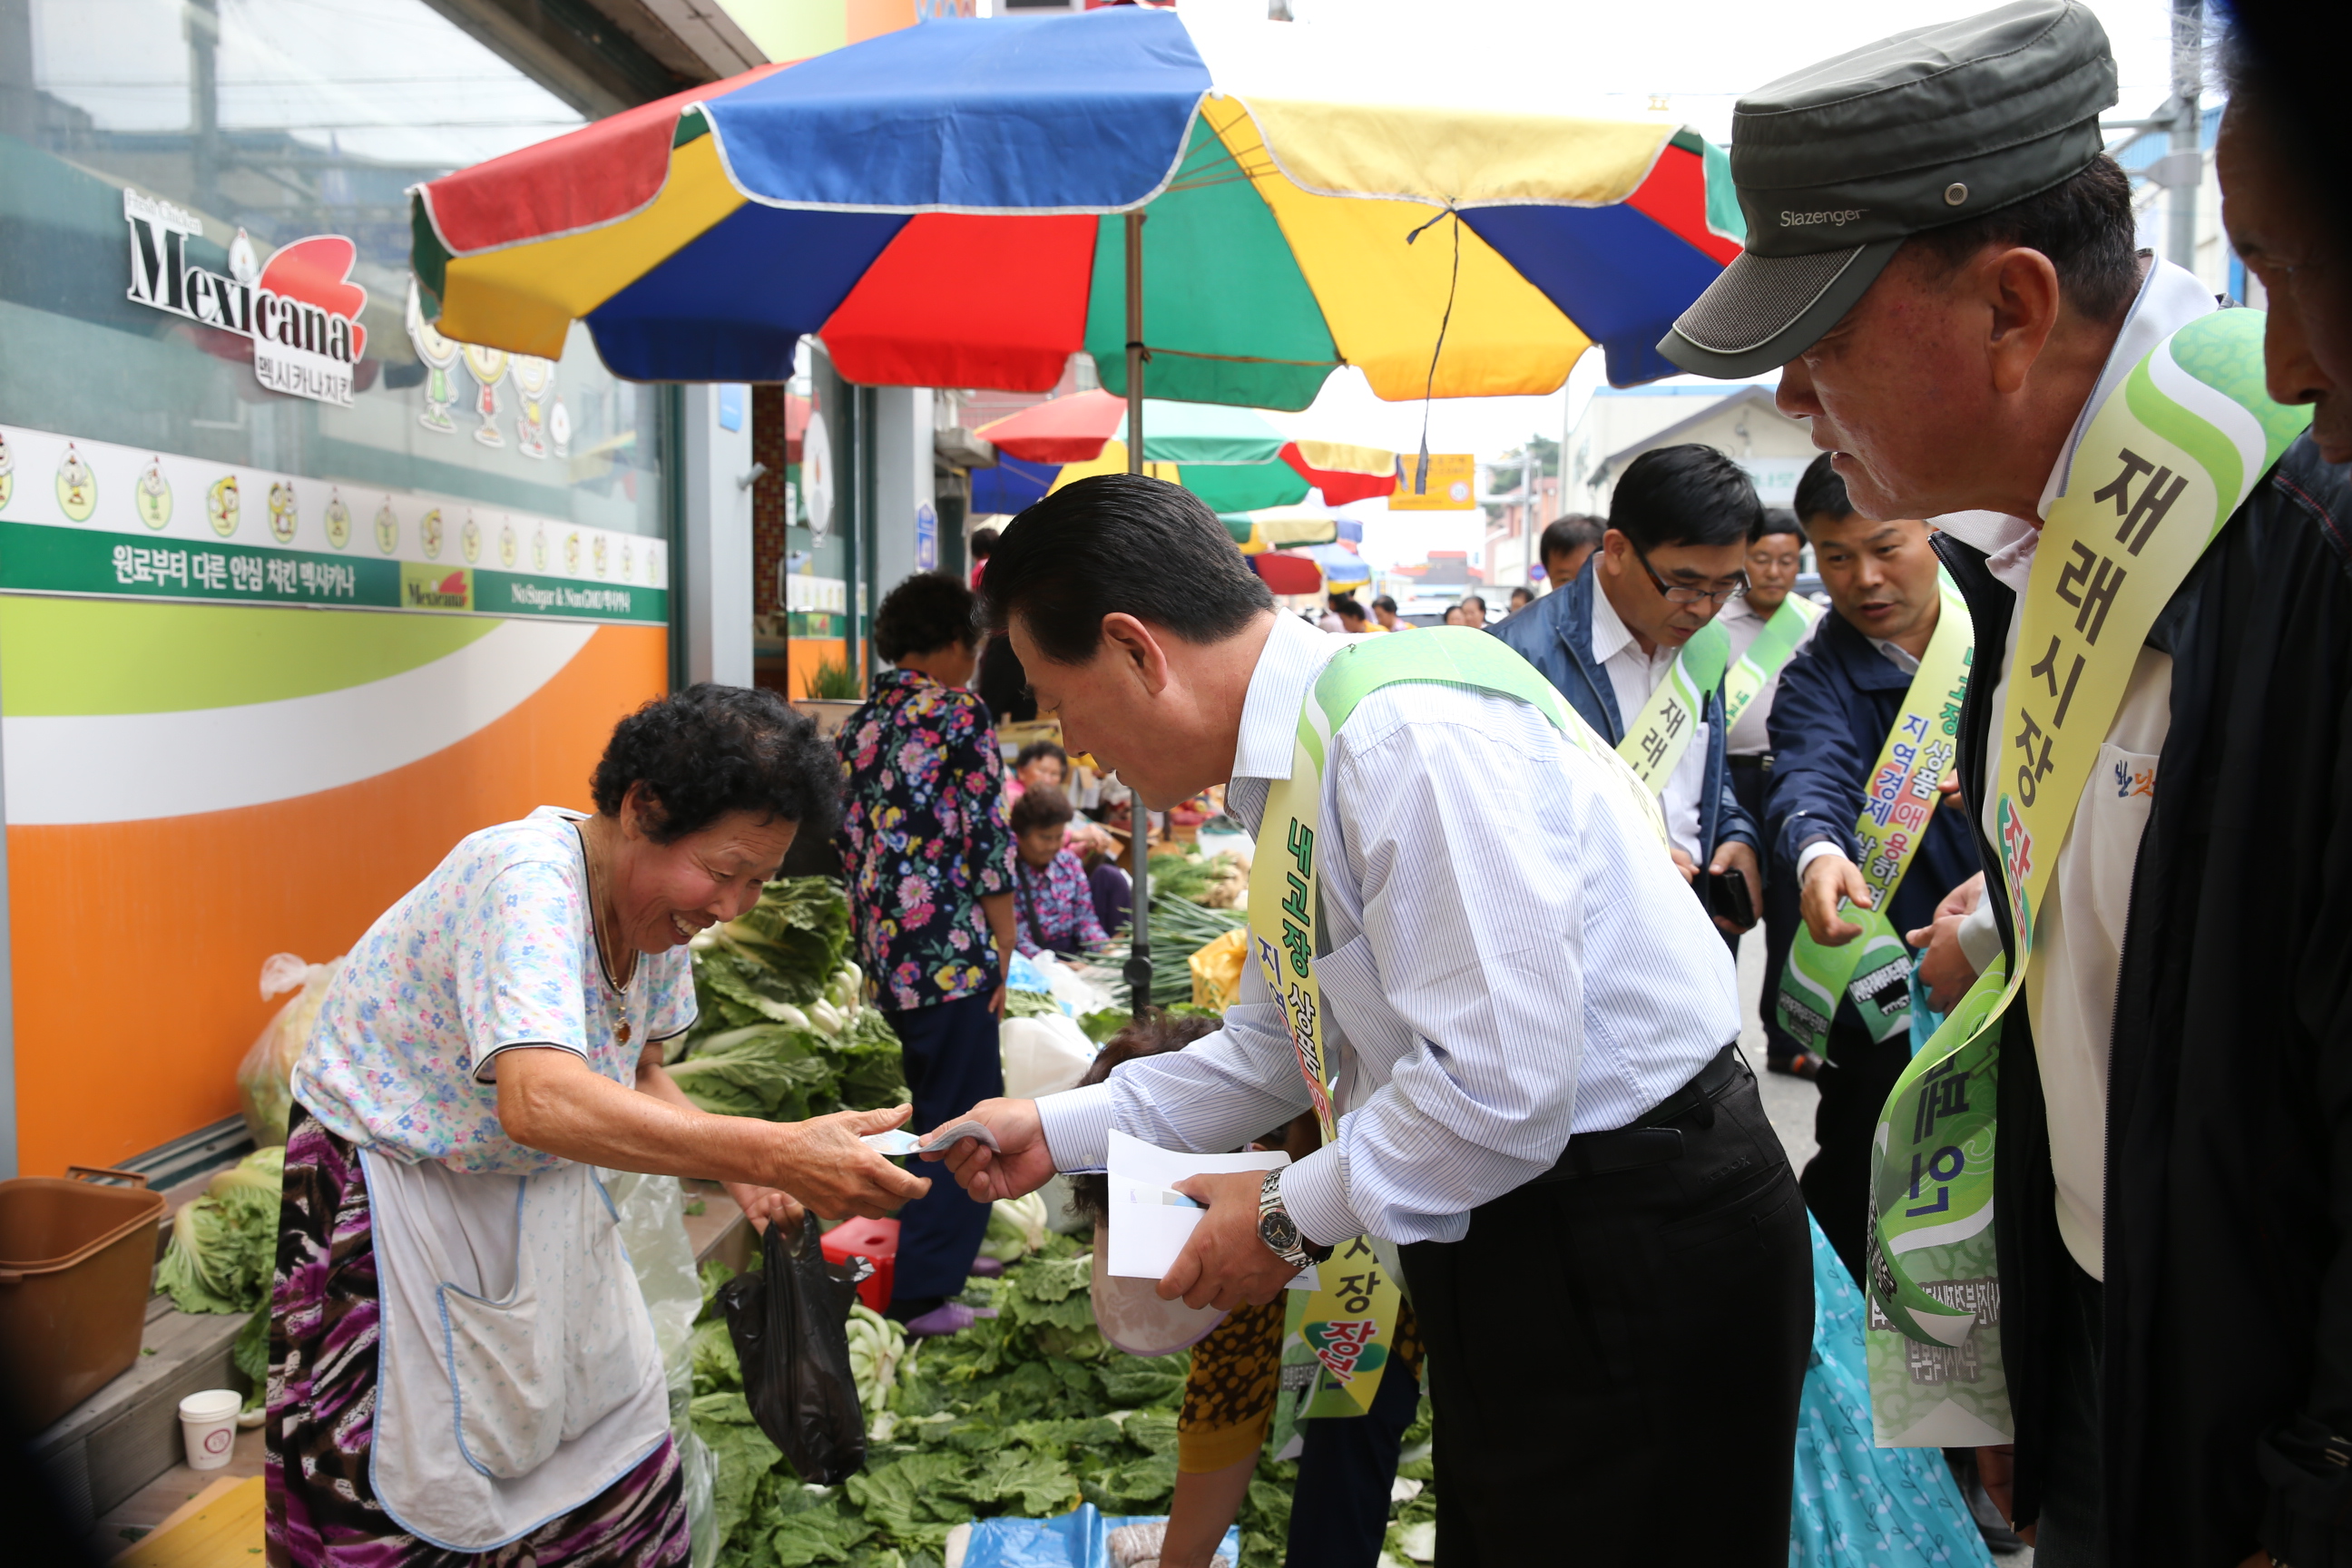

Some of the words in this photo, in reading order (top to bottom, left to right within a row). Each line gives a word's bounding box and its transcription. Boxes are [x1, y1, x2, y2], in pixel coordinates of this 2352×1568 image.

[1780, 210, 1861, 227] Slazenger
[130, 218, 354, 364] Mexicana
[259, 356, 354, 405] 멕시카나치킨
[112, 544, 188, 589] 원료부터
[191, 552, 228, 590] 다른
[230, 554, 264, 592] 안심
[267, 558, 298, 594] 치킨
[299, 561, 356, 598] 멕시카나
[2015, 447, 2189, 808] 재래시장
[1633, 697, 1686, 782] 재래
[1863, 712, 1930, 828] 지역경제
[1911, 740, 1953, 800] 상품
[1282, 817, 1314, 979] 내고장
